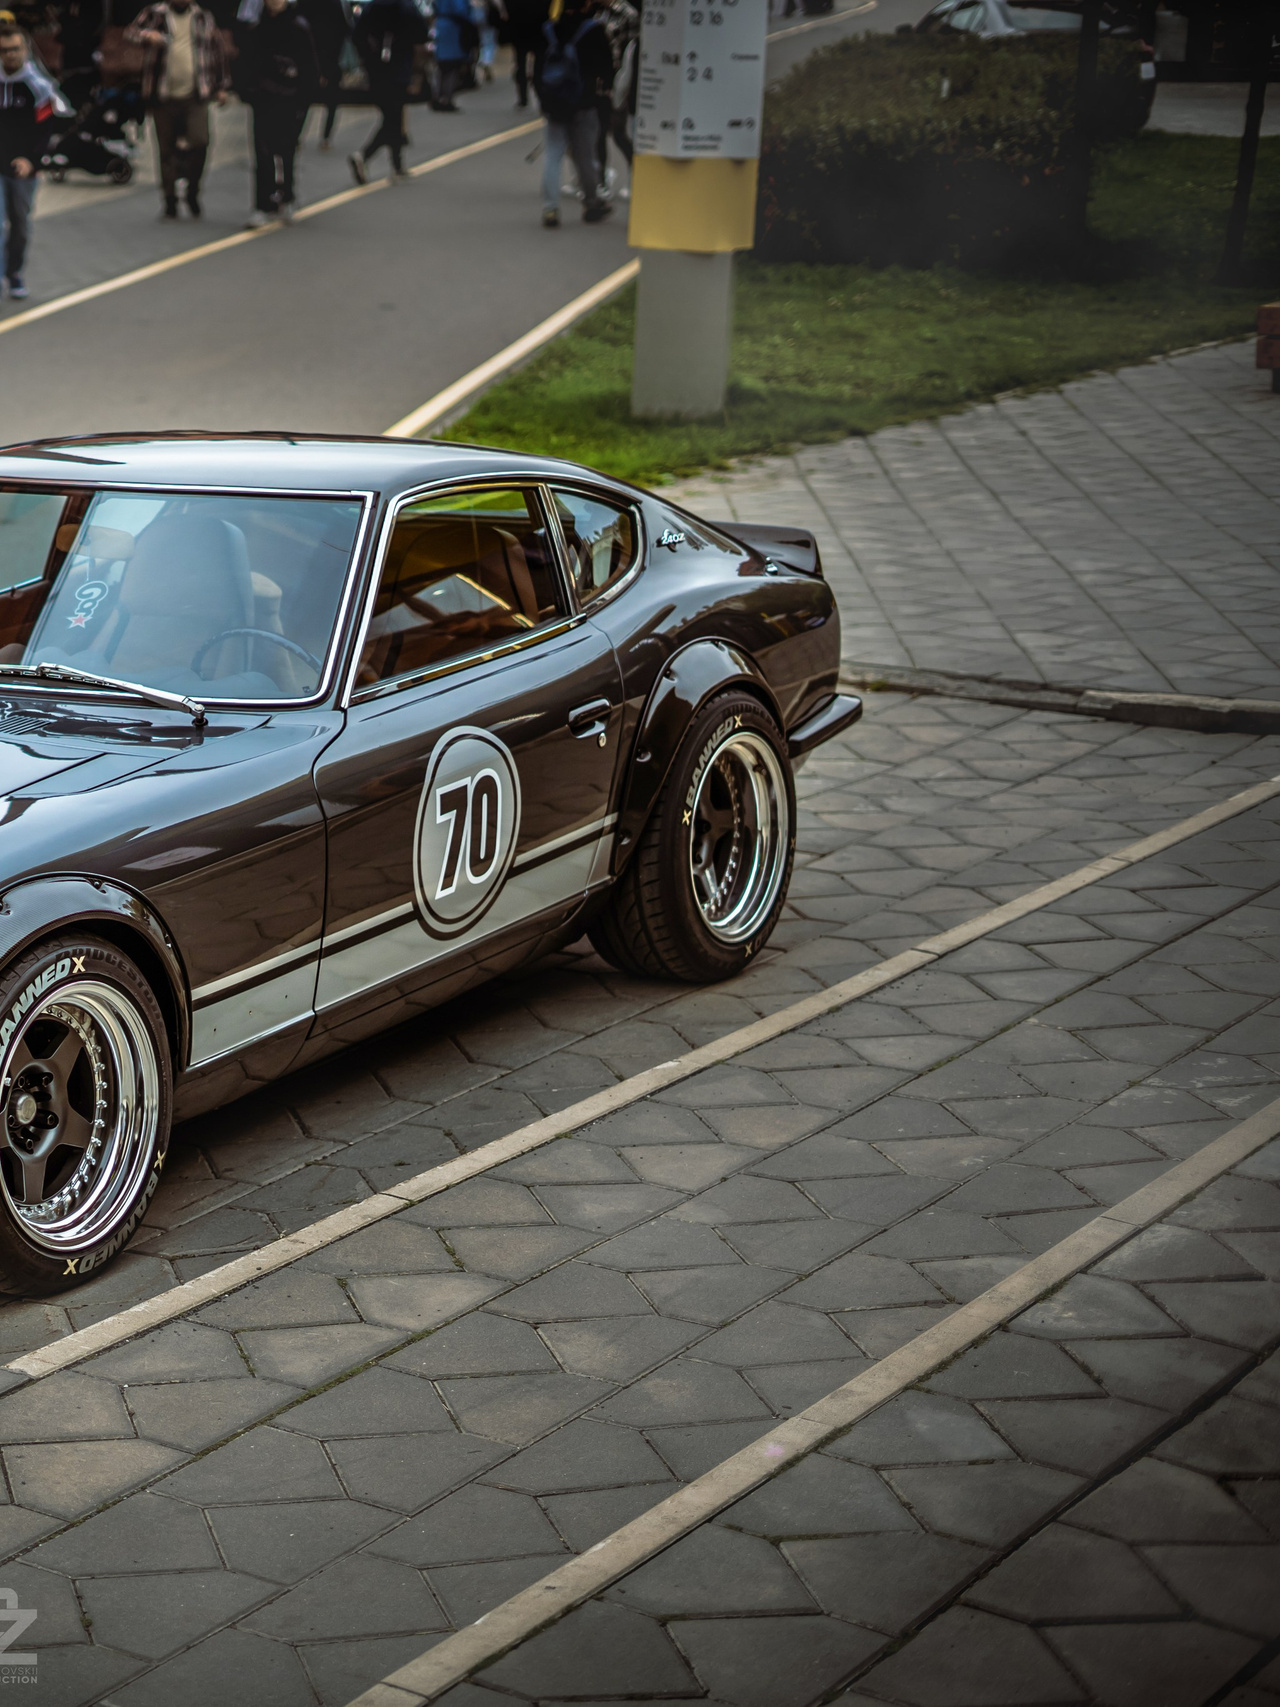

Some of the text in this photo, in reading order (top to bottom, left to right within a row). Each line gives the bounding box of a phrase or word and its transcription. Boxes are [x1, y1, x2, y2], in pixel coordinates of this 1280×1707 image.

[685, 716, 734, 808] BANNED
[734, 714, 742, 728] X
[435, 768, 502, 900] 70
[72, 956, 86, 973] X
[63, 1150, 166, 1275] X BANNED X
